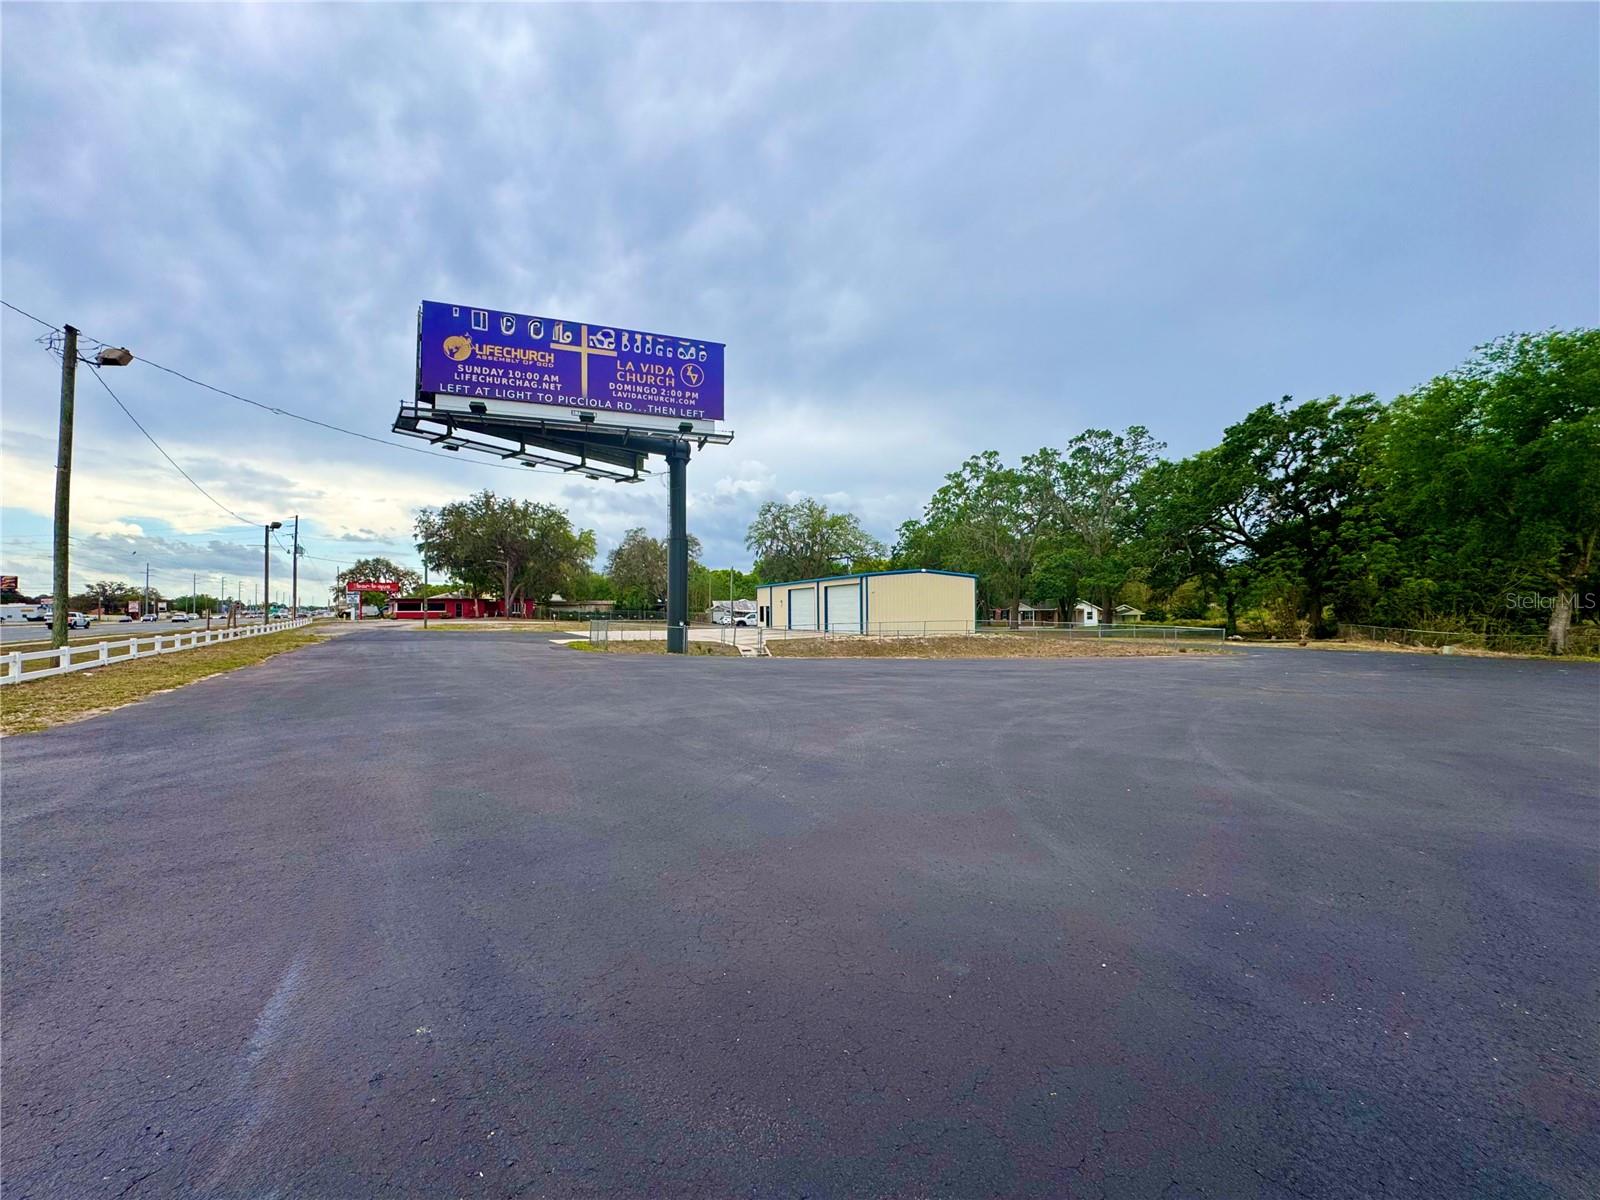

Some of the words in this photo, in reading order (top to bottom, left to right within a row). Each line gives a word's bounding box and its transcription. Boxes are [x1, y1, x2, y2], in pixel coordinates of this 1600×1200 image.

[475, 343, 554, 363] LIFECHURCH
[476, 355, 520, 364] ASSEMBLY
[457, 364, 505, 376] SUNDAY
[508, 370, 540, 381] 10:00
[542, 374, 559, 383] AM
[616, 360, 635, 372] LA
[640, 363, 675, 377] VIDA
[454, 373, 562, 391] LIFECHURCHAG.NET
[616, 371, 675, 387] CHURCH
[609, 382, 658, 395] DOMINGO
[660, 388, 682, 398] 2:00
[685, 391, 699, 400] PM
[612, 390, 696, 406] LAVIDACHURCH.COM
[440, 383, 471, 394] LEFT
[475, 387, 490, 396] AT
[495, 389, 533, 400] LIGHT
[537, 392, 553, 403] TO
[558, 395, 612, 409] PICCIOLA
[680, 408, 705, 418] LEFT
